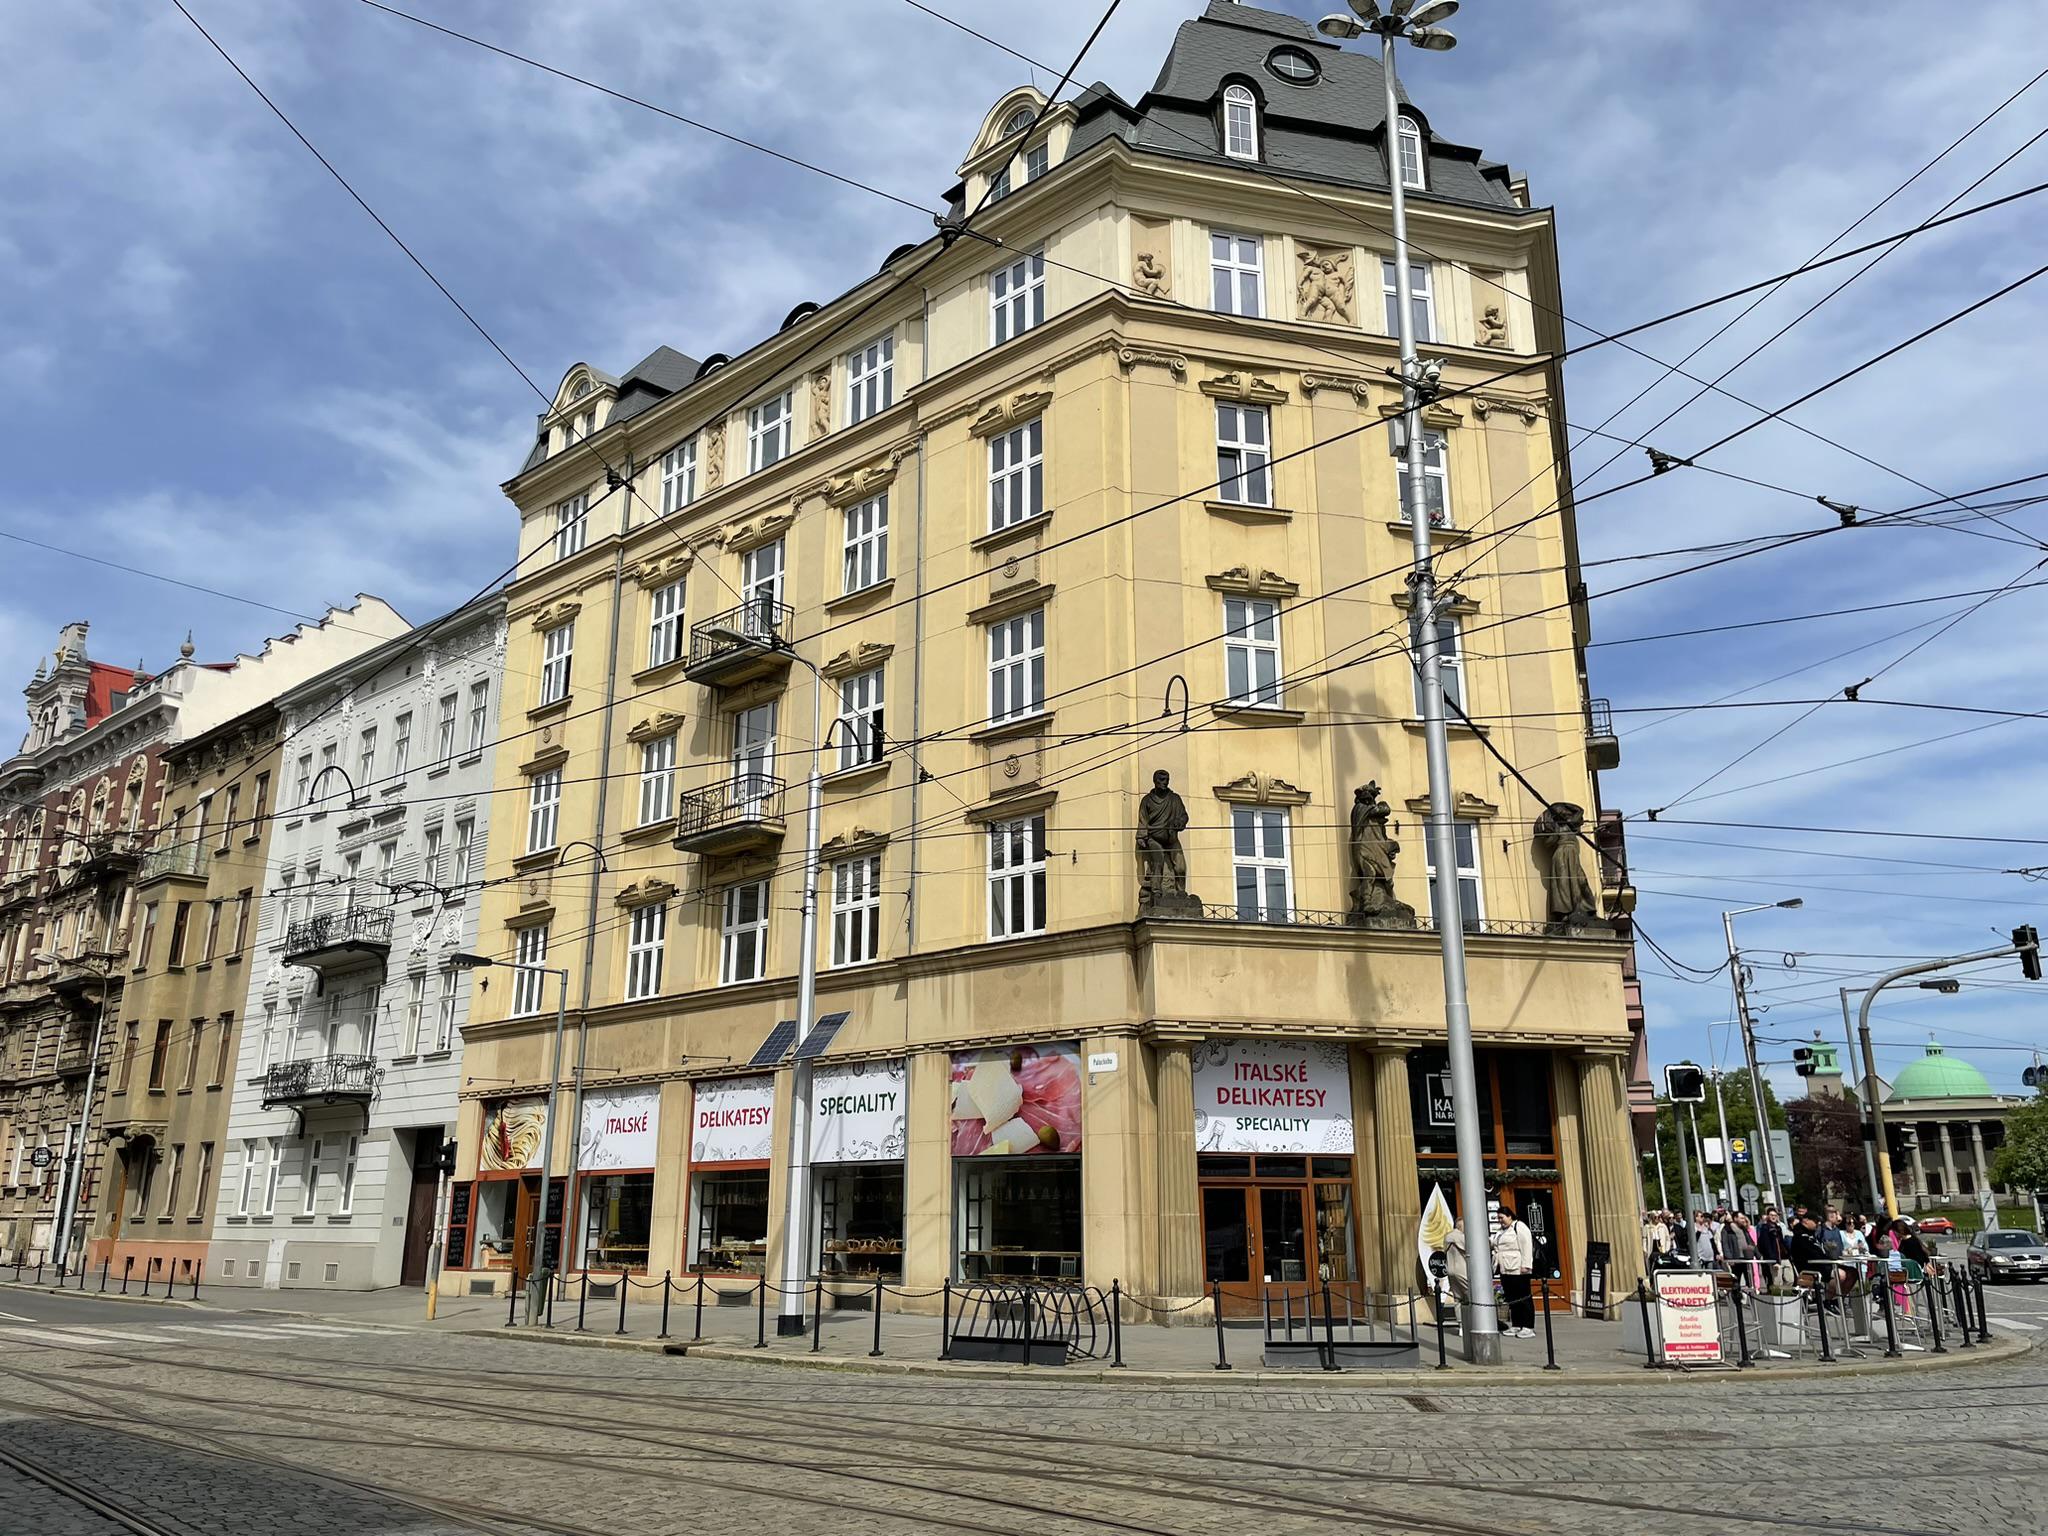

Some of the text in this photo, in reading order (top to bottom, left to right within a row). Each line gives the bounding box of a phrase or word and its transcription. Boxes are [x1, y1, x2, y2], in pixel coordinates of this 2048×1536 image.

[1234, 1060, 1308, 1083] ITALSKÉ
[819, 1092, 897, 1116] SPECIALITY
[1217, 1087, 1327, 1108] DELIKATESY
[1434, 1098, 1454, 1111] KA
[605, 1111, 648, 1135] ITALSKÉ
[699, 1107, 771, 1129] DELIKATESY
[1236, 1117, 1311, 1132] SPECIALITY
[1435, 1111, 1446, 1119] NA
[1661, 1285, 1711, 1295] ELEKTRONICKÉ
